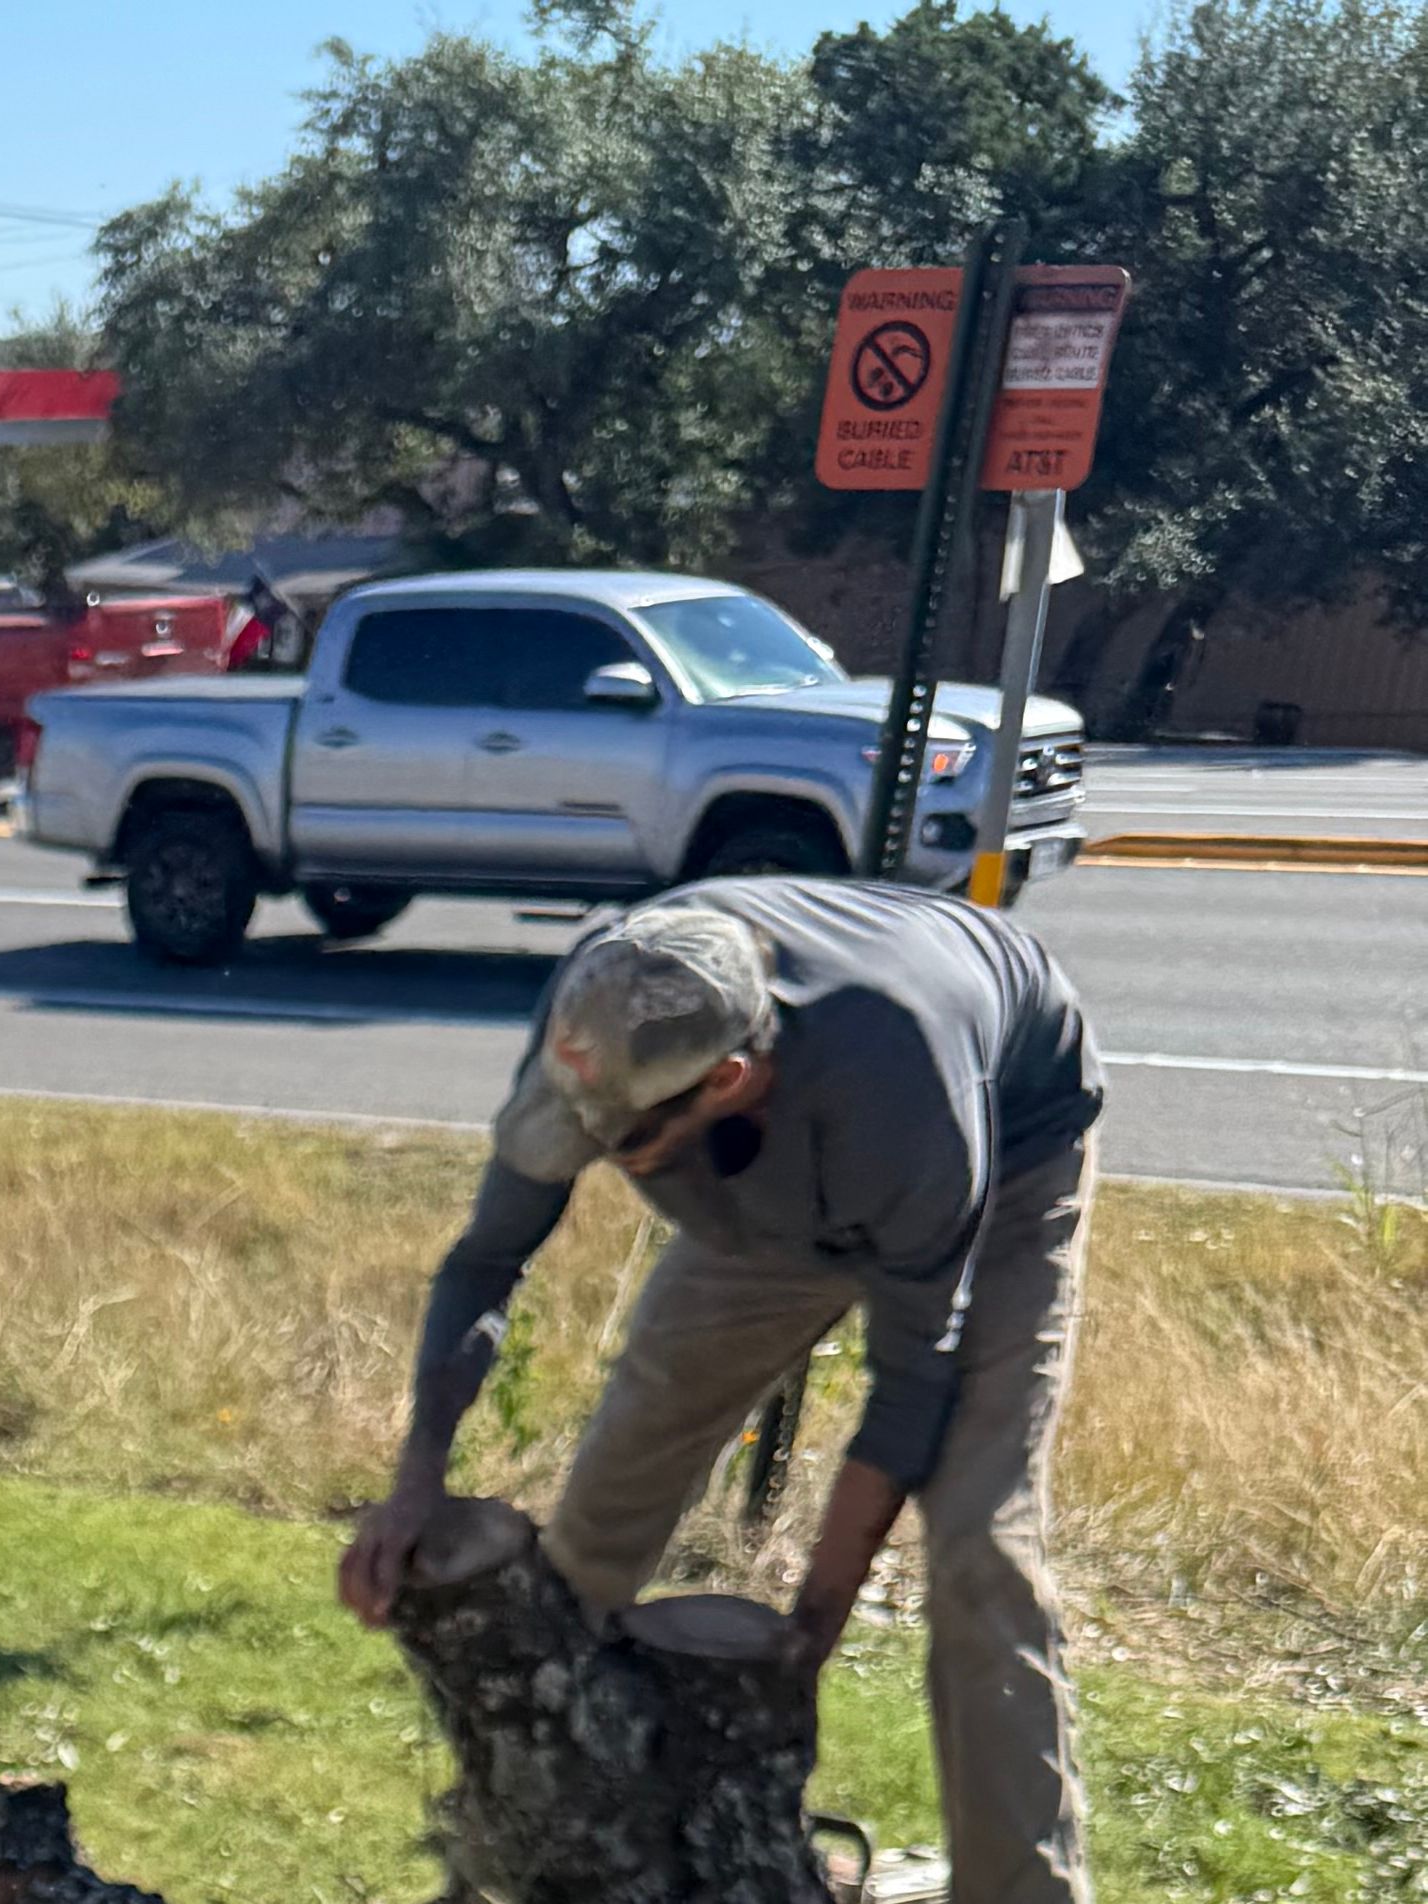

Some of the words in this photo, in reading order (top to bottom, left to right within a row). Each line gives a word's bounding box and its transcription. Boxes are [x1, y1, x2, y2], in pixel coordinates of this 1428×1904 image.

[848, 289, 956, 311] WARNING
[836, 420, 923, 440] BURIED
[837, 450, 913, 470] CABLE
